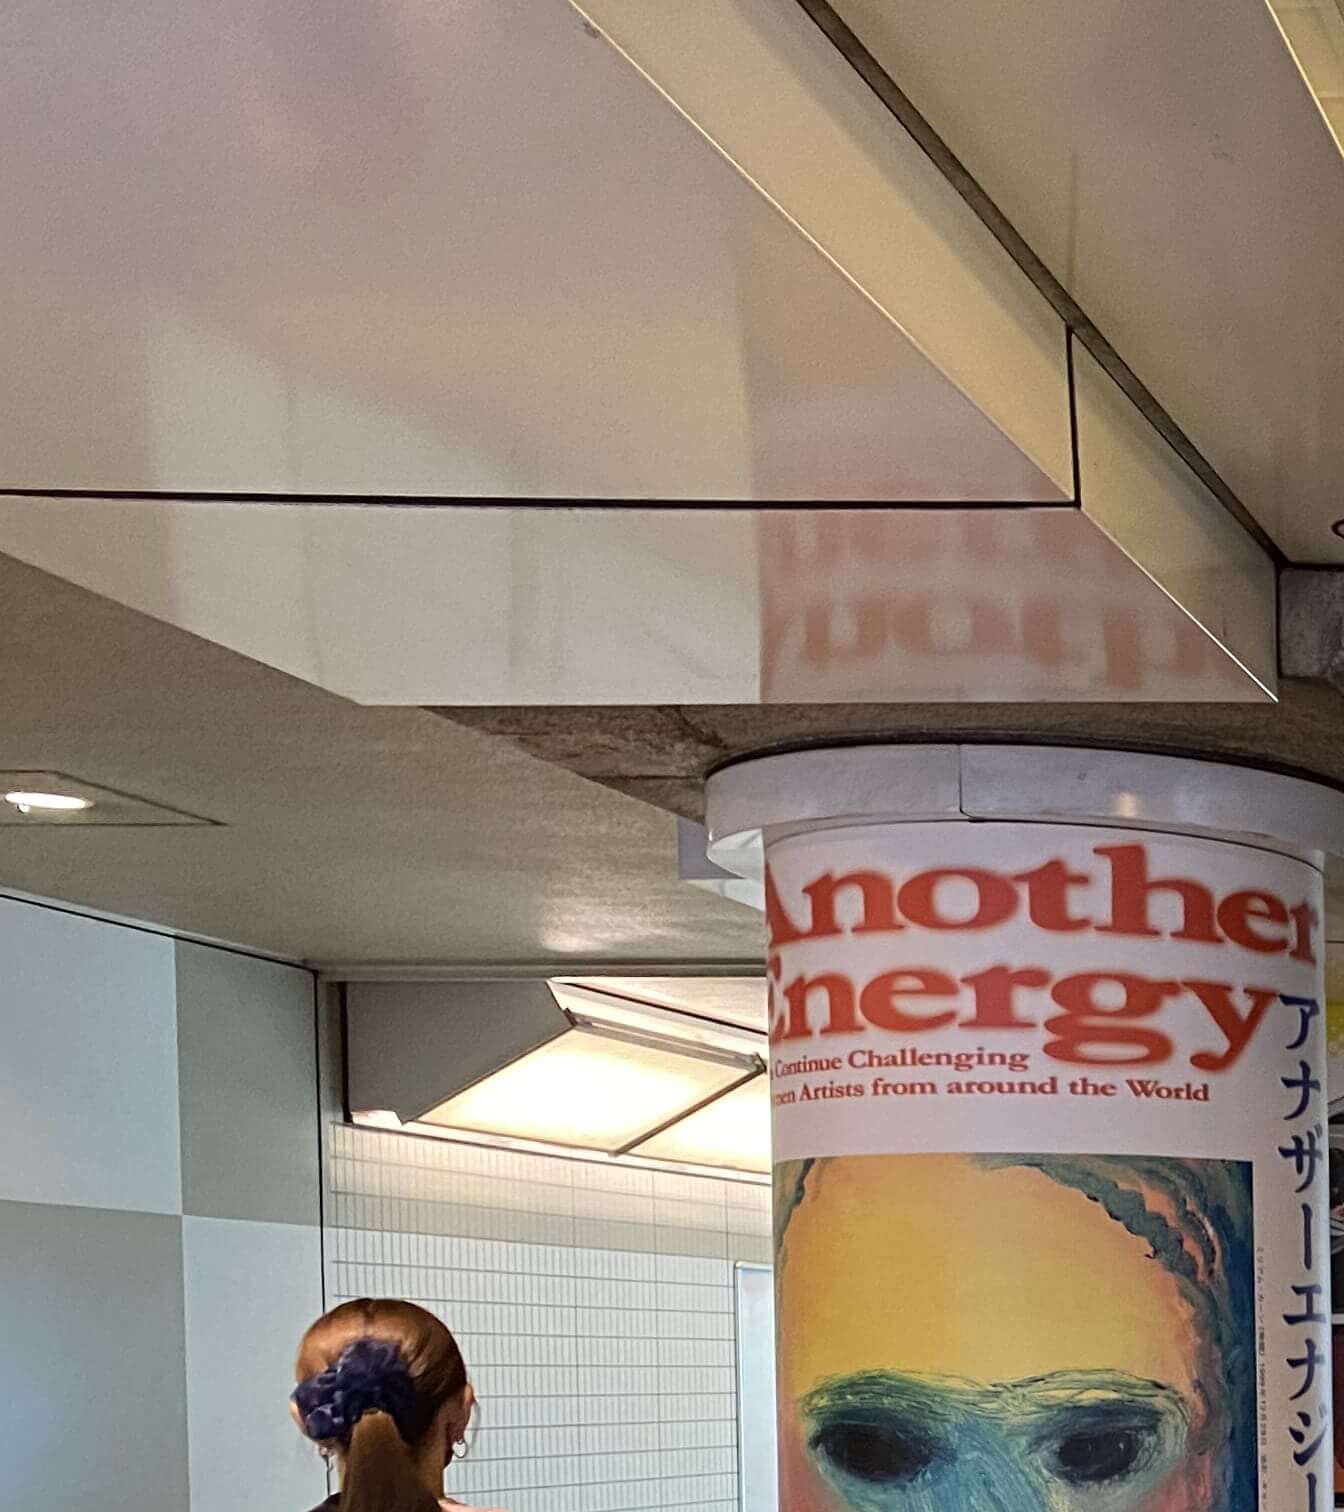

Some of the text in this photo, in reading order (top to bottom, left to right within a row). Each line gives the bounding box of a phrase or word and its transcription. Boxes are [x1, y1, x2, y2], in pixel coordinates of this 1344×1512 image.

[775, 1046, 1030, 1079] Continue Challenging
[801, 1077, 1210, 1102] Artists from around the World
